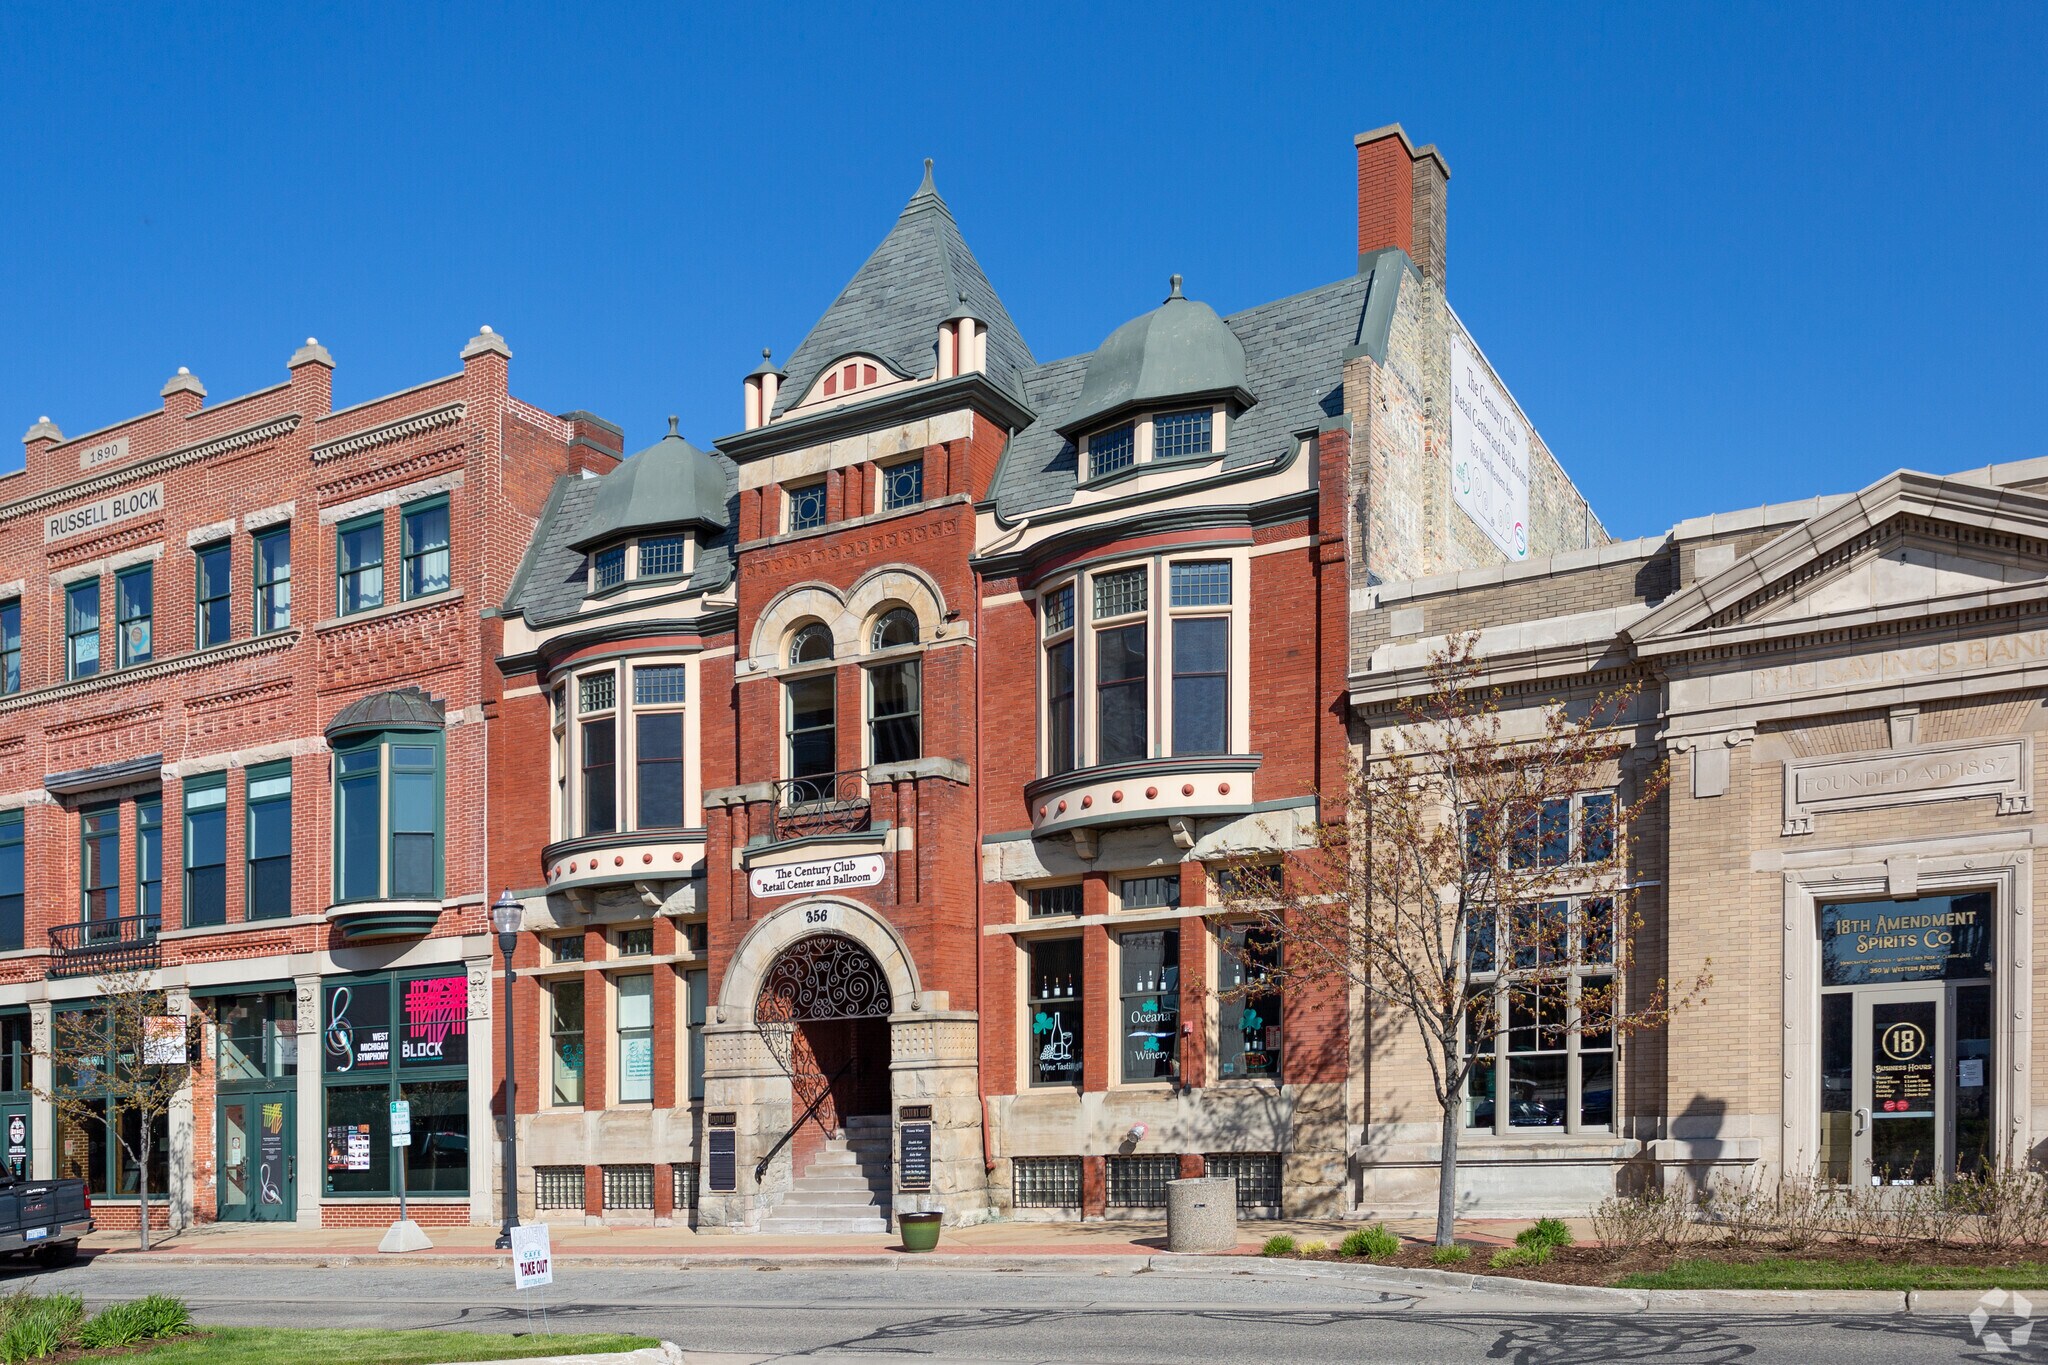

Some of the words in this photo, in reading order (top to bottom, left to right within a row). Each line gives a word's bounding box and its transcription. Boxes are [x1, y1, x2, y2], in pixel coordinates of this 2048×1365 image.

[1467, 366, 1479, 397] The
[1480, 384, 1503, 433] Century
[1503, 416, 1518, 446] Club
[1454, 384, 1472, 422] Retail
[1472, 408, 1492, 444] Center
[1491, 436, 1501, 457] and
[90, 444, 118, 463] 1890
[50, 505, 108, 537] RUSSELL
[113, 488, 158, 518] BLOCK
[1757, 664, 1814, 693] THE
[1823, 645, 1958, 685] SAVINGS
[1803, 767, 1907, 794] FOUNDED
[775, 868, 792, 879] The
[793, 865, 831, 877] Century
[833, 860, 856, 872] Club
[762, 882, 785, 893] Retail
[787, 879, 814, 890] Center
[816, 876, 831, 886] and
[833, 873, 871, 885] Ballroom
[805, 909, 828, 924] 356
[1836, 918, 1871, 935] 18TH
[1875, 911, 1977, 934] AMENDMENT
[1856, 934, 1917, 953] SPIRITS
[1131, 1011, 1171, 1023] Oceana
[372, 1032, 389, 1041] WEST
[1893, 1030, 1914, 1053] 18
[360, 1042, 389, 1051] MICHIGAN
[402, 1042, 443, 1058] BLOCK
[1134, 1050, 1169, 1062] Winery
[357, 1052, 389, 1062] SYMPHONY
[1039, 1063, 1056, 1071] Wine
[524, 1250, 541, 1259] CAFE
[520, 1261, 536, 1277] TAKE
[536, 1259, 548, 1275] OUT
